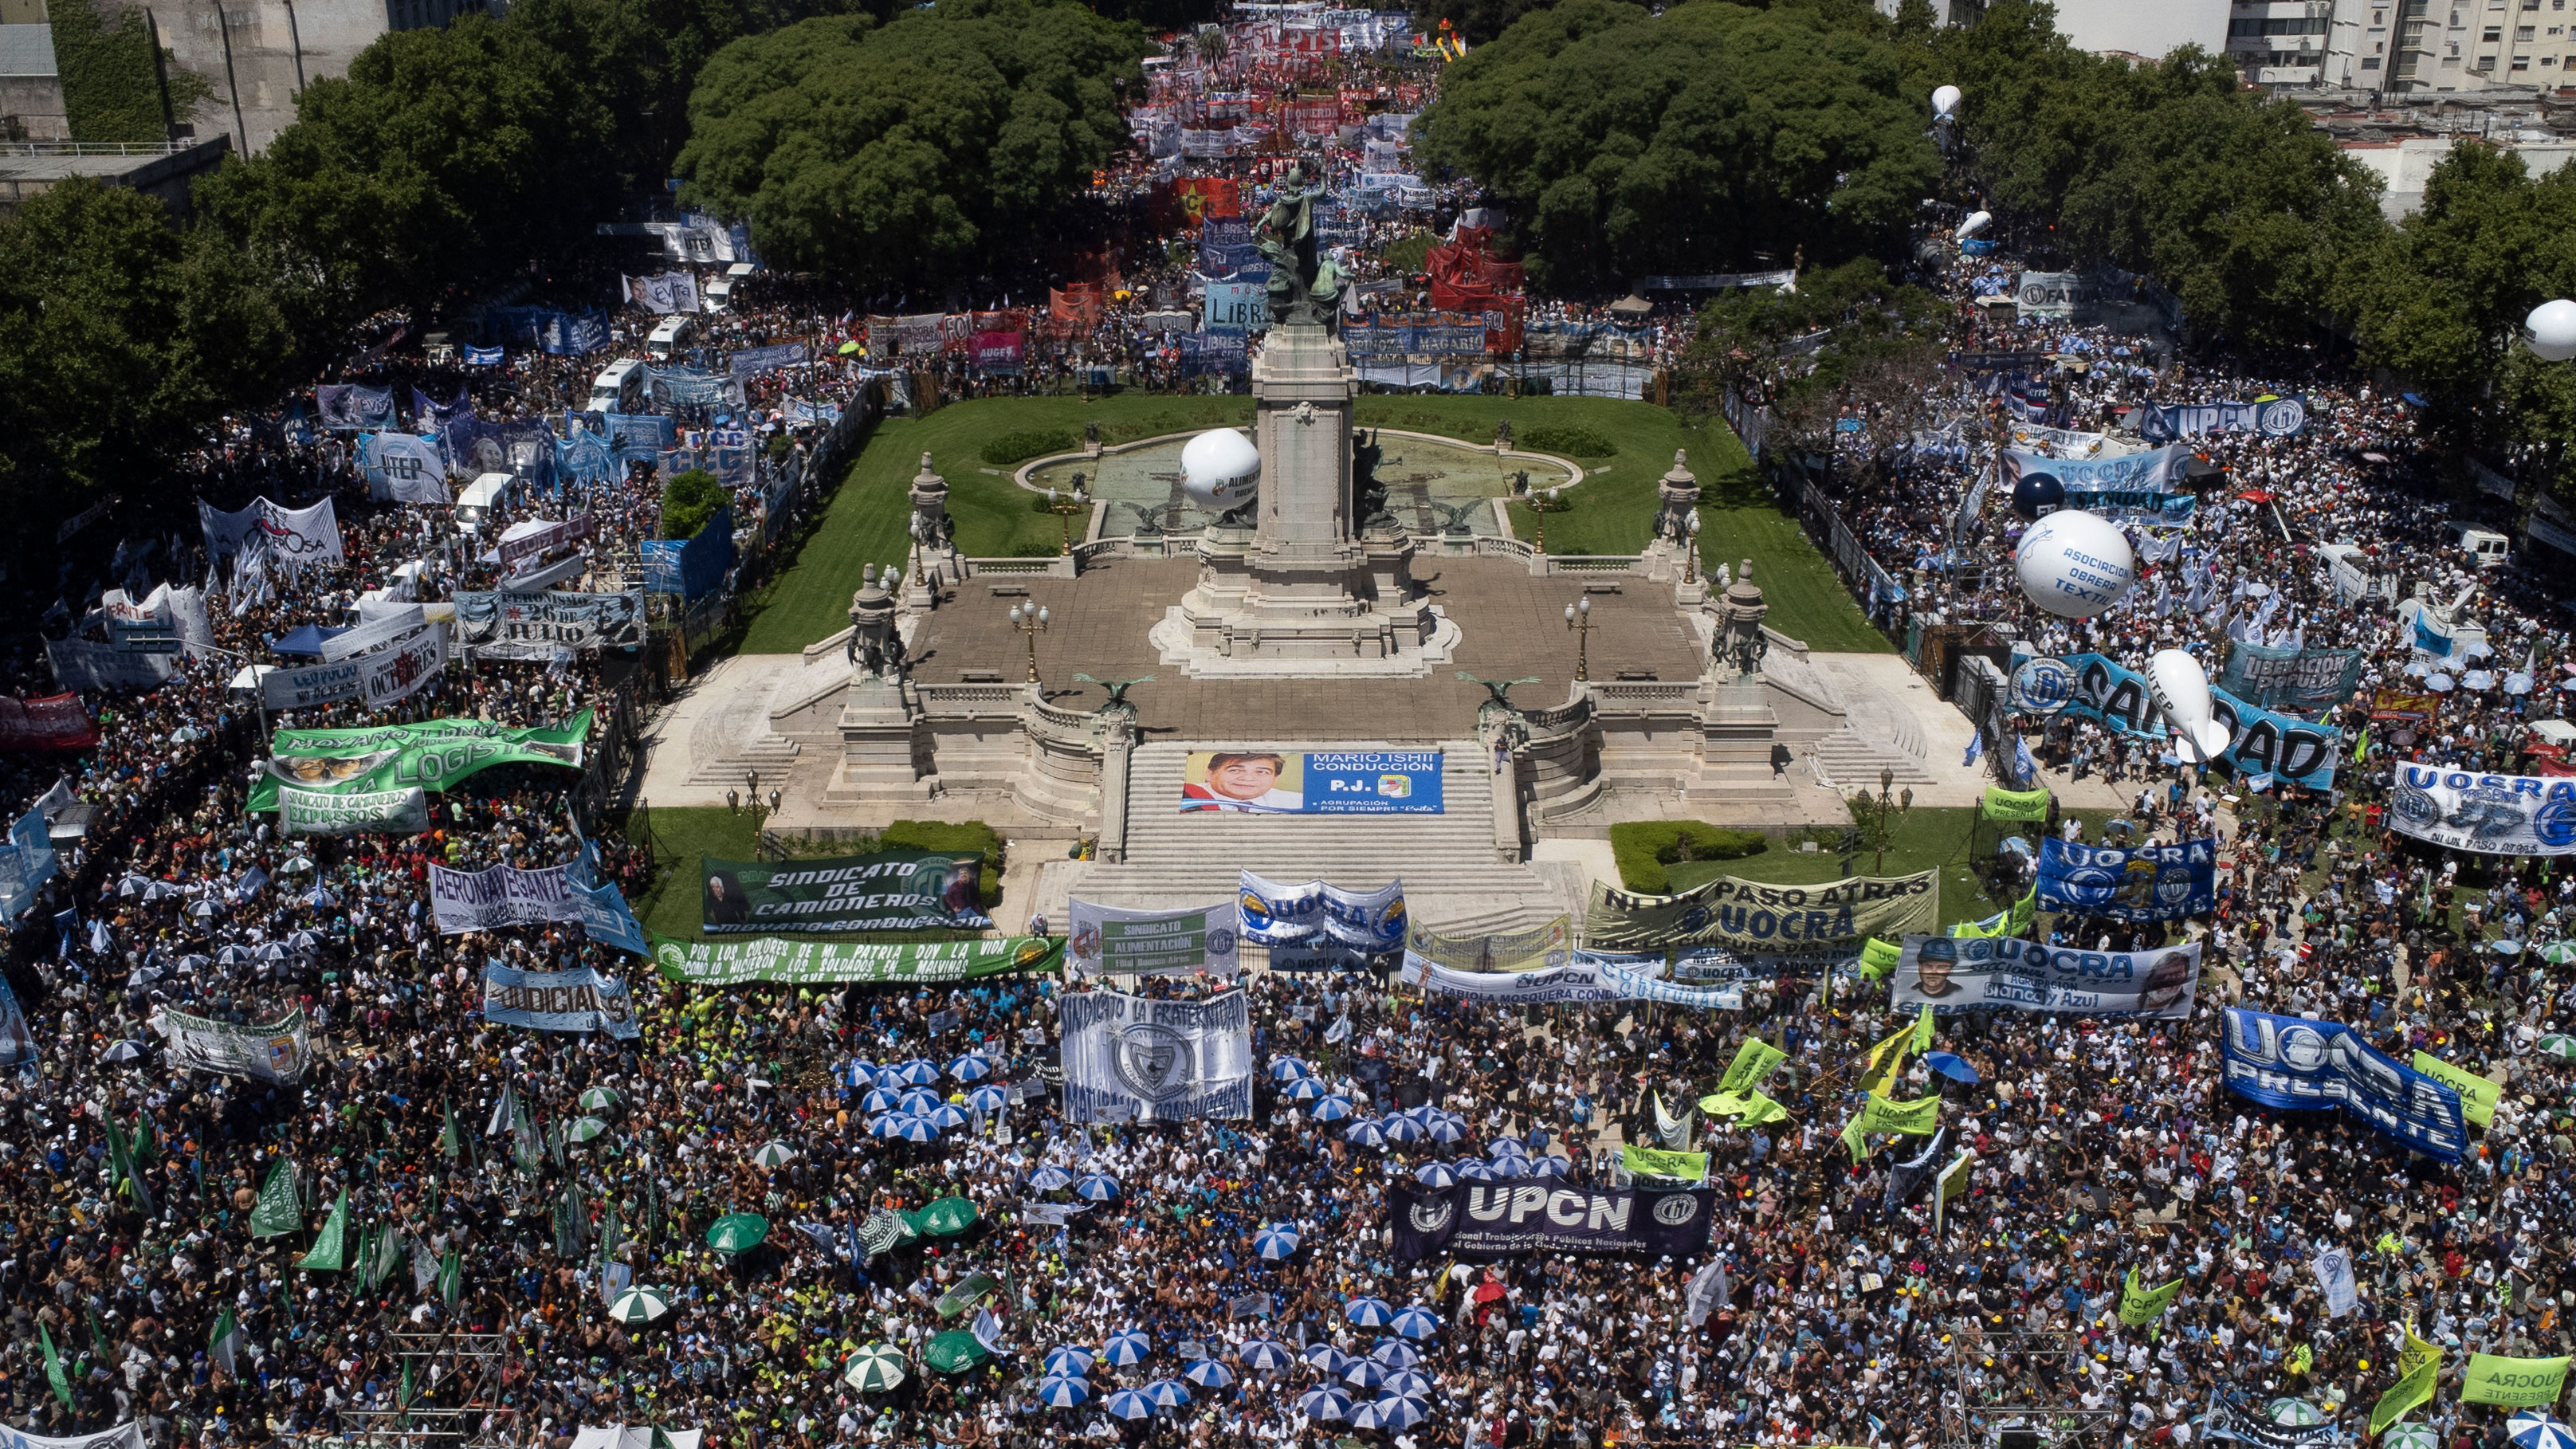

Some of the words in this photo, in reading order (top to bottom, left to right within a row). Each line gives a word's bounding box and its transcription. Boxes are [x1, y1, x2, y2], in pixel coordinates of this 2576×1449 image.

[1289, 29, 1336, 52] PTS
[1284, 108, 1339, 118] IZQUIERDA
[1380, 175, 1412, 184] SADOP
[1186, 194, 1199, 210] C
[1215, 222, 1250, 235] LIBRES
[686, 236, 713, 251] UTEP
[1212, 298, 1266, 324] LiBR
[1379, 312, 1484, 327] MATANZA
[980, 347, 1007, 358] AUGE
[1199, 336, 1245, 351] LIBRES
[1419, 335, 1484, 351] MAGARIO
[2044, 340, 2053, 351] E
[2179, 404, 2257, 438] UPCN
[381, 454, 422, 481] UTEP
[2060, 459, 2148, 482] UOCRA
[2063, 548, 2129, 579] ASOCIACION
[2069, 567, 2118, 592] OBRERA
[501, 591, 589, 607] PERONISMO
[2055, 578, 2111, 606] TEXTIL
[528, 603, 556, 623] 26
[559, 610, 579, 623] DE
[503, 623, 586, 642] JULIO
[2242, 654, 2346, 681] LIBERACIÓN
[296, 689, 310, 704] NO
[312, 681, 358, 701] DEJEMOS
[2254, 673, 2341, 694] POPULAR
[2074, 660, 2329, 779] SADAD
[285, 728, 410, 750] MOYANO
[1313, 753, 1384, 763] MARIO
[1388, 753, 1434, 763] ISHII
[1313, 760, 1434, 772] CONDUCCIÓN
[1329, 779, 1372, 791] P.J.
[288, 790, 330, 807] SINDICATO
[333, 794, 345, 809] DE
[348, 789, 408, 808] CAMIONEROS
[1995, 797, 2038, 810] UOCRA
[2460, 788, 2523, 805] PRESENTE
[289, 805, 385, 826] EXPRESOS
[1994, 807, 2038, 819] PRESENTE
[2464, 836, 2496, 851] PASO
[2502, 842, 2538, 854] ATRAS
[2060, 843, 2208, 868] UOCRA
[767, 862, 918, 888] SINDICATO
[826, 882, 866, 898] DE
[1714, 881, 1808, 907] PASO
[1819, 878, 1930, 907] ATRAS
[497, 903, 525, 923] PABLO
[527, 901, 548, 922] BREY
[754, 893, 938, 916] CAMIONEROS
[717, 921, 824, 933] MOYANO
[1124, 920, 1182, 936] SINDICATO
[1719, 903, 1855, 939] UOCRA
[690, 944, 711, 961] POR
[717, 944, 739, 961] LOS
[747, 937, 789, 958] COLORES
[799, 944, 815, 959] DE
[821, 944, 838, 960] MI
[853, 944, 903, 960] PATRIA
[915, 944, 942, 960] DOY
[951, 943, 970, 960] LA
[980, 939, 1008, 956] VIDA
[1115, 934, 1192, 954] ALIMENTACIÓN
[684, 960, 709, 976] COMO
[710, 960, 722, 976] LO
[728, 956, 778, 975] HICIERON
[787, 958, 809, 973] LOS
[819, 958, 875, 973] SOLDADOS
[882, 959, 899, 973] EN
[915, 959, 970, 975] MALVINAS
[1137, 956, 1165, 968] Buenos
[1167, 953, 1190, 966] Aires
[1996, 940, 2134, 979] UOCRA
[770, 970, 793, 983] LOS
[799, 972, 825, 983] QUE
[886, 973, 963, 984] ABANDONAN
[1533, 970, 1596, 987] UPCN
[1702, 967, 1745, 979] UOCRA
[1969, 963, 2046, 980] SECCIONAL
[2010, 975, 2078, 992] AGRUPACION
[1442, 985, 1495, 1002] FABIOLA
[1500, 988, 1573, 1003] MOSQUERA
[1984, 981, 2046, 1005] Blanca
[2046, 993, 2056, 1007] y
[2060, 993, 2099, 1008] Azul
[501, 984, 627, 1024] JUDICIALS
[1061, 993, 1125, 1035] SINDICATO
[1132, 999, 1147, 1022] LA
[1151, 993, 1247, 1030] FRATERNIDAD
[2425, 1067, 2478, 1103] UOCRA
[2226, 1058, 2457, 1153] PRESENTE
[1875, 1118, 1920, 1128] PRESENTE
[1636, 1150, 1688, 1168] UOCRA
[1468, 1185, 1632, 1231] UPCN
[1464, 1240, 1507, 1251] Gobierno
[1553, 1234, 1592, 1246] Públicos
[1596, 1237, 1647, 1248] Nacionales
